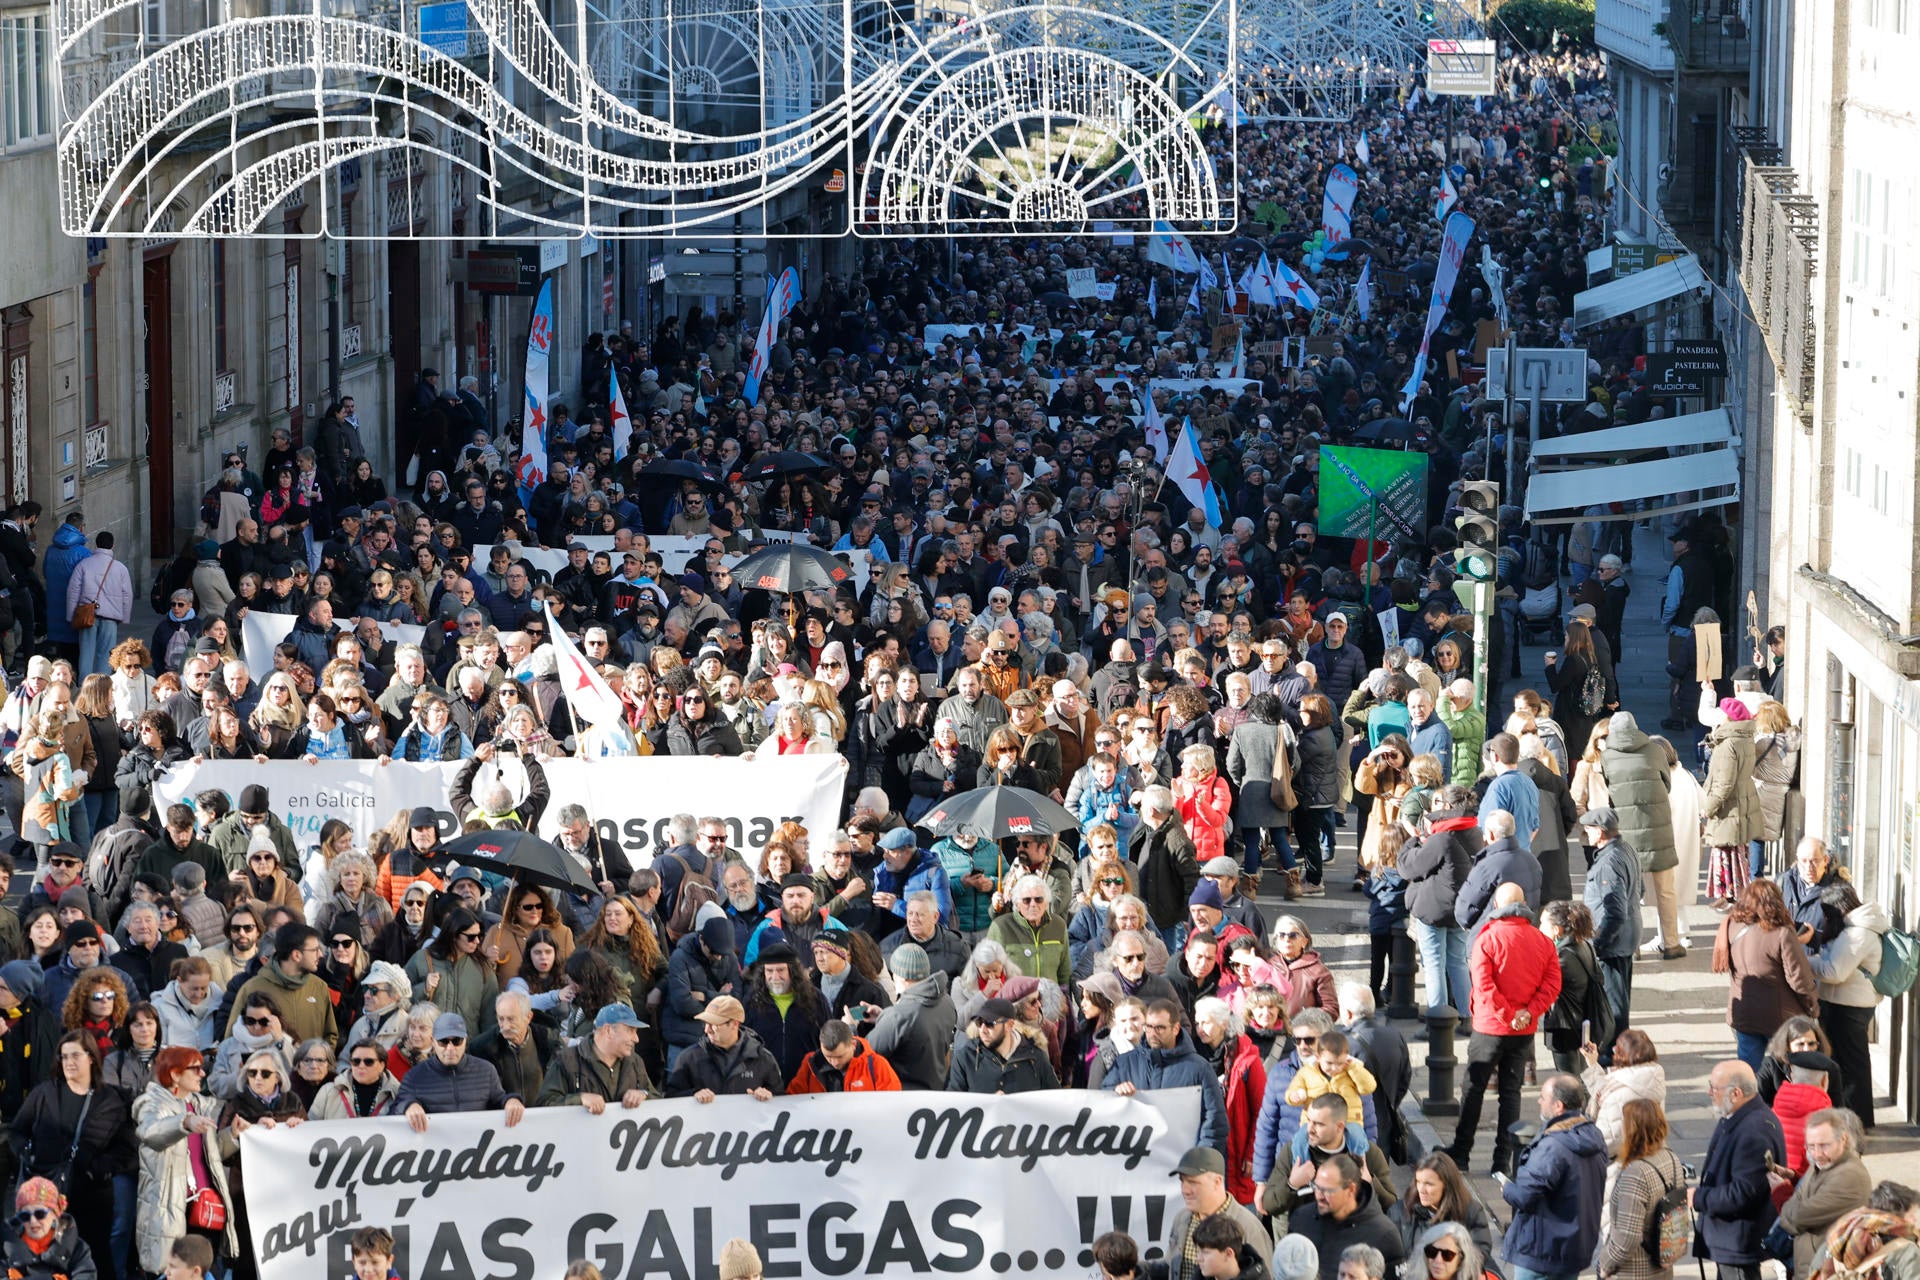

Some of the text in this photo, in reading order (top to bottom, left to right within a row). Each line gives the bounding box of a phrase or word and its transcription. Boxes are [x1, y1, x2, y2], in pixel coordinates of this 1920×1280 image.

[1676, 346, 1719, 354] PANADERIA
[1674, 361, 1720, 370] PASTELERIA
[288, 791, 376, 808] en Galicia
[1008, 816, 1031, 827] ALTRI
[1009, 825, 1033, 834] NON
[309, 1106, 1154, 1198] Mayday, Mayday, Mayday
[261, 1181, 362, 1264] aquí
